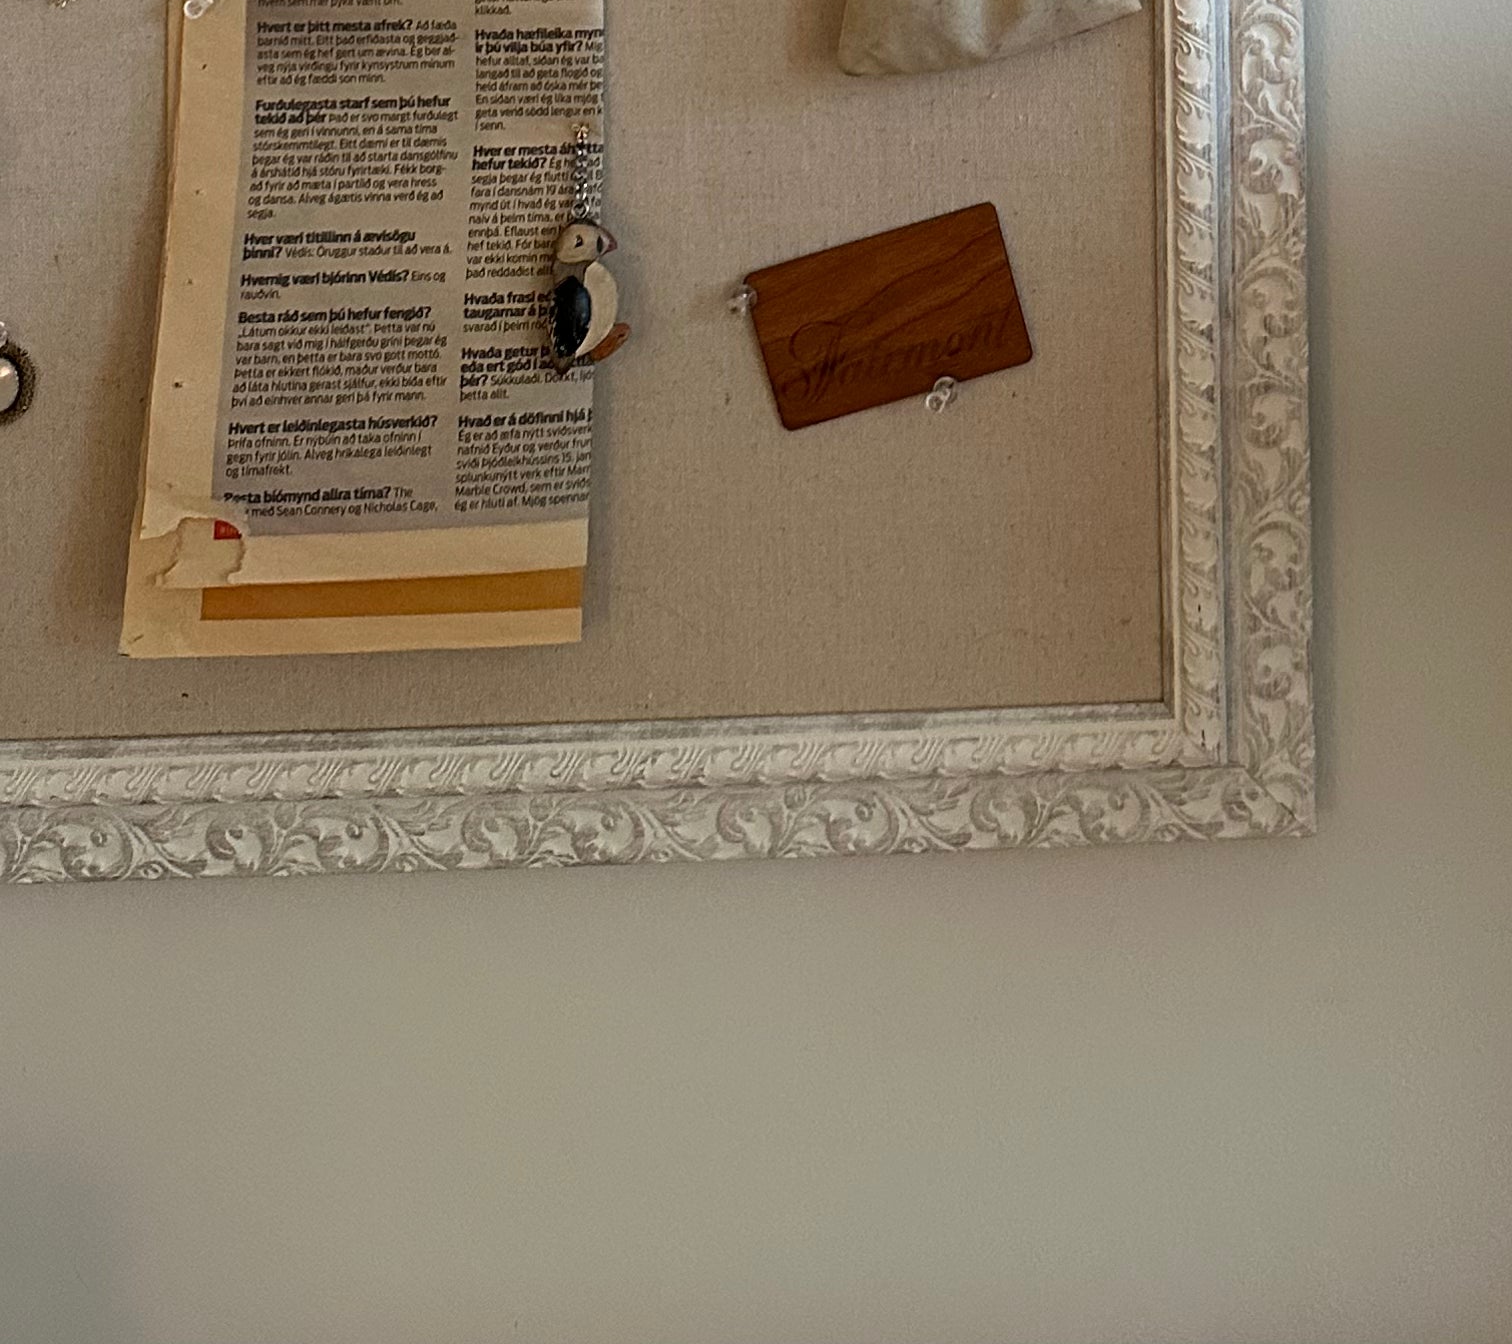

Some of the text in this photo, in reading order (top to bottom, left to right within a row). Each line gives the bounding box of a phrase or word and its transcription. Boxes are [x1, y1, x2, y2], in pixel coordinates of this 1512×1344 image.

[257, 22, 291, 33] Hvert
[333, 22, 371, 32] mesta
[373, 19, 413, 31] afrek?
[339, 97, 370, 109] starf
[371, 99, 397, 108] sem
[417, 95, 451, 107] hefur
[473, 144, 557, 157] Hver mesta
[472, 158, 506, 170] hefur
[244, 233, 274, 245] Hver
[238, 311, 275, 324] Besta
[299, 312, 327, 322] sem
[347, 308, 382, 321] hefur
[228, 422, 265, 435] Hvert
